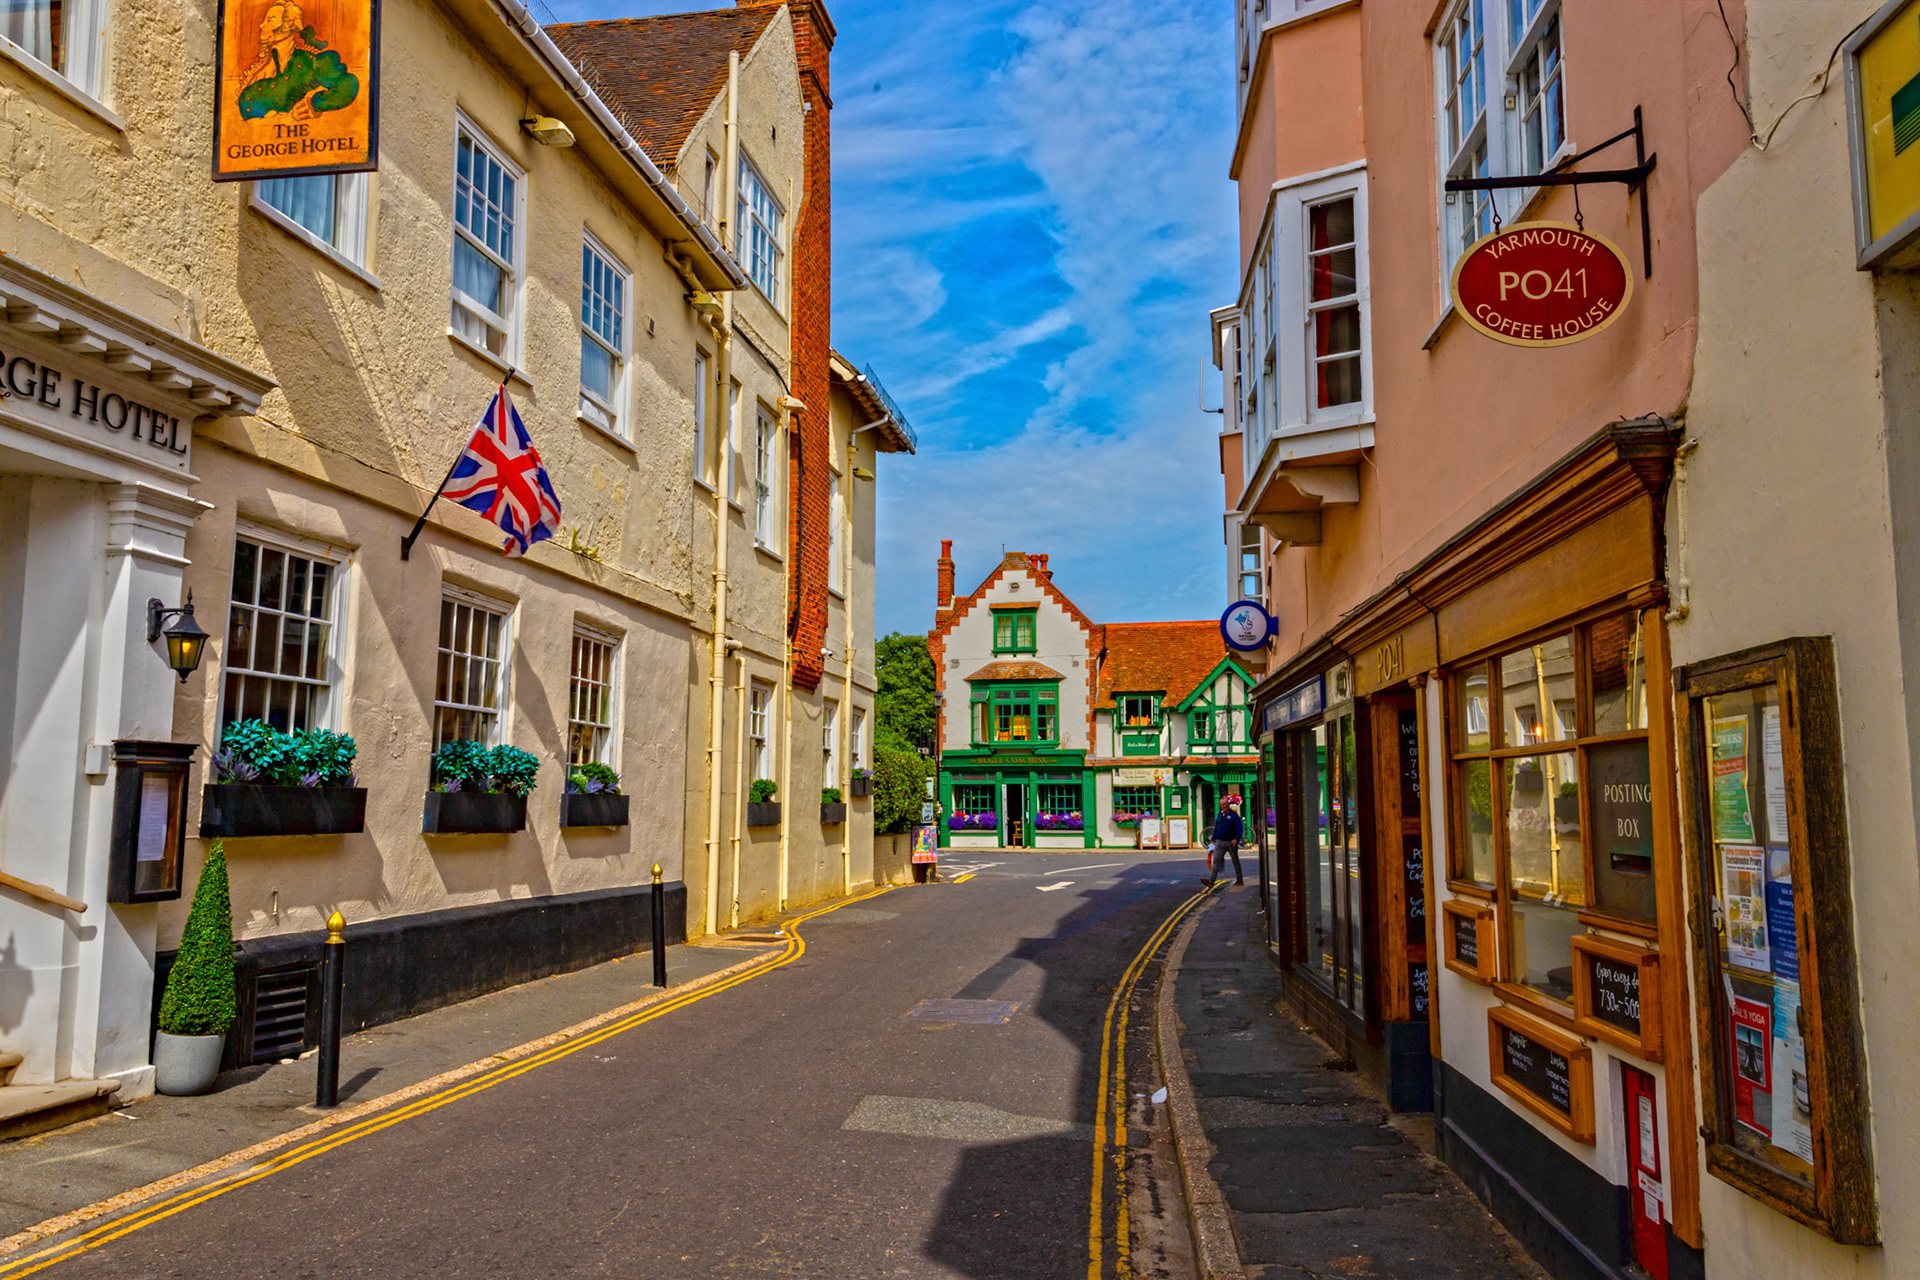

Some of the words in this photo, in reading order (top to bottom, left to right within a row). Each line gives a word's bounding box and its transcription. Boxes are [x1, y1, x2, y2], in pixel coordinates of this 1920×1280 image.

[273, 124, 310, 138] THE
[227, 141, 299, 159] GEORGE
[301, 137, 360, 153] HOTEL
[1485, 230, 1596, 259] YARMOUTH
[1499, 268, 1587, 301] PO41
[1476, 303, 1544, 339] COFFEE
[1550, 297, 1613, 339] HOUSE
[0, 351, 61, 408] GE
[72, 379, 187, 454] HOTEL
[1376, 635, 1404, 683] PO41
[1604, 784, 1652, 803] POSTING
[1617, 818, 1640, 838] BOX
[1596, 962, 1613, 985] Open
[1748, 1011, 1766, 1025] YOGA
